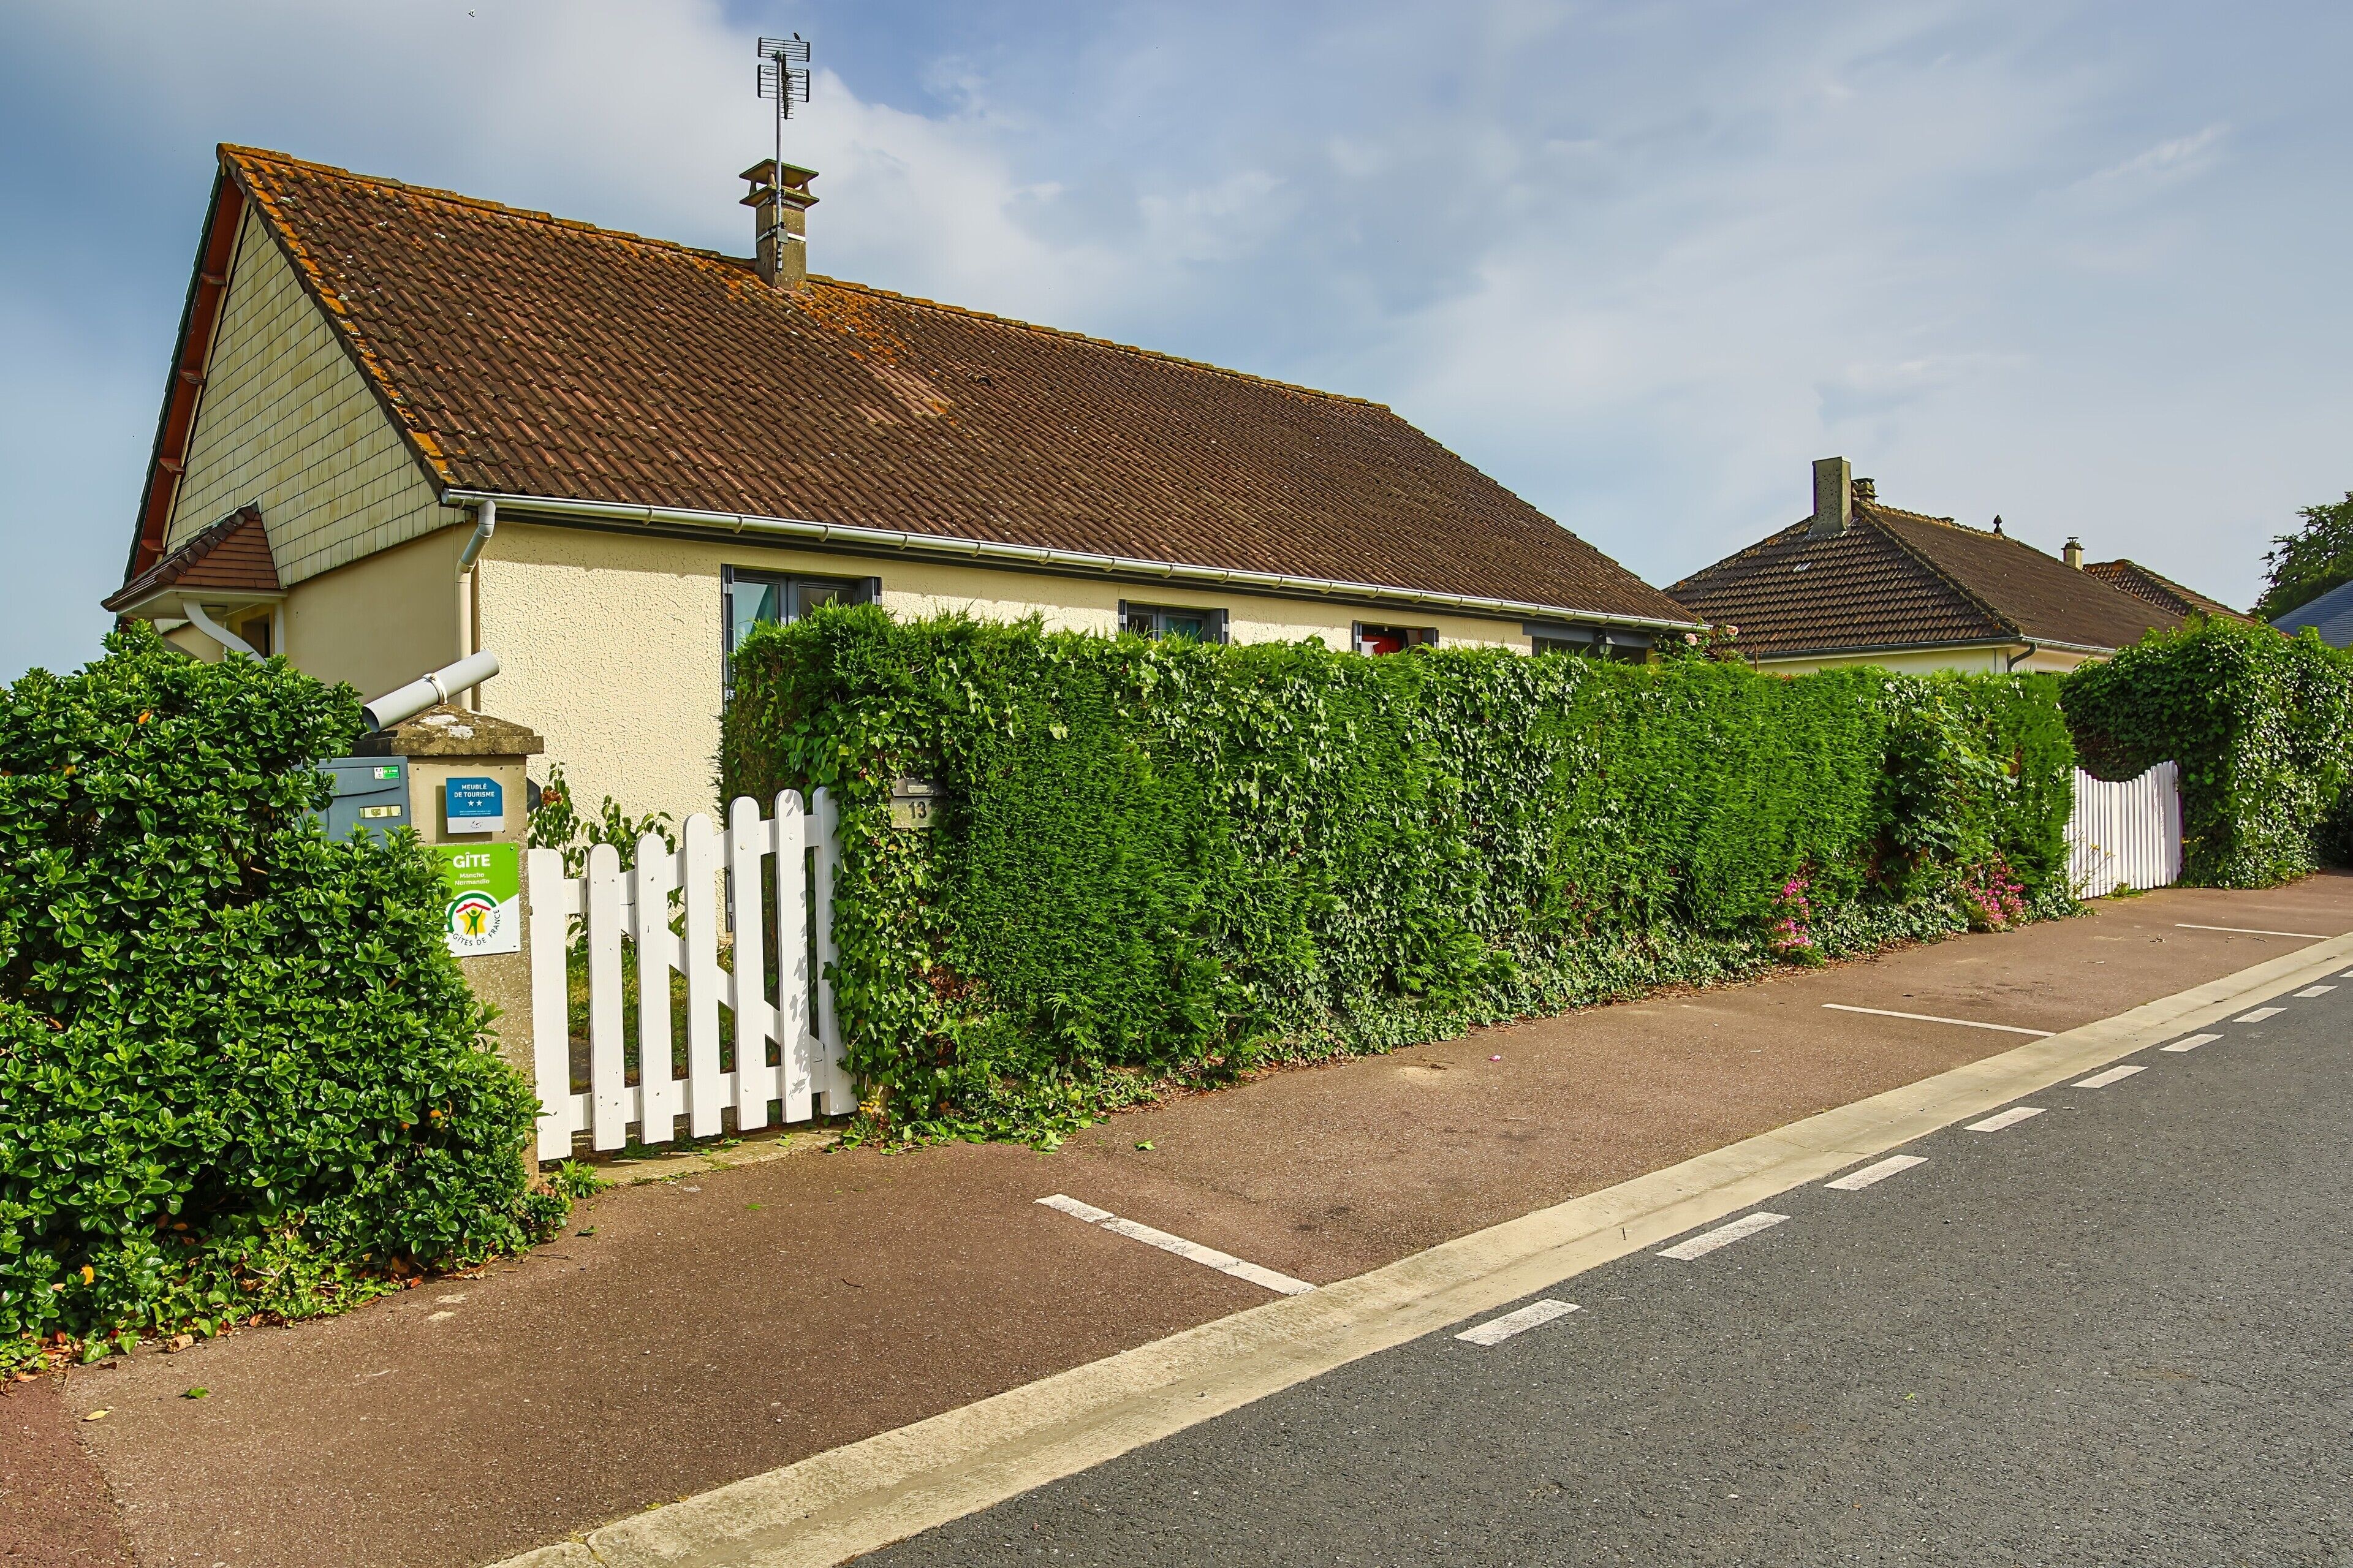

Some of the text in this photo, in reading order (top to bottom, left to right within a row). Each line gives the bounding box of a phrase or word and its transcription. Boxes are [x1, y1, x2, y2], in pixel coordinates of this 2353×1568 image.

[909, 801, 926, 819] 13
[453, 852, 491, 868] GÎTE
[488, 909, 501, 938] FRANCE
